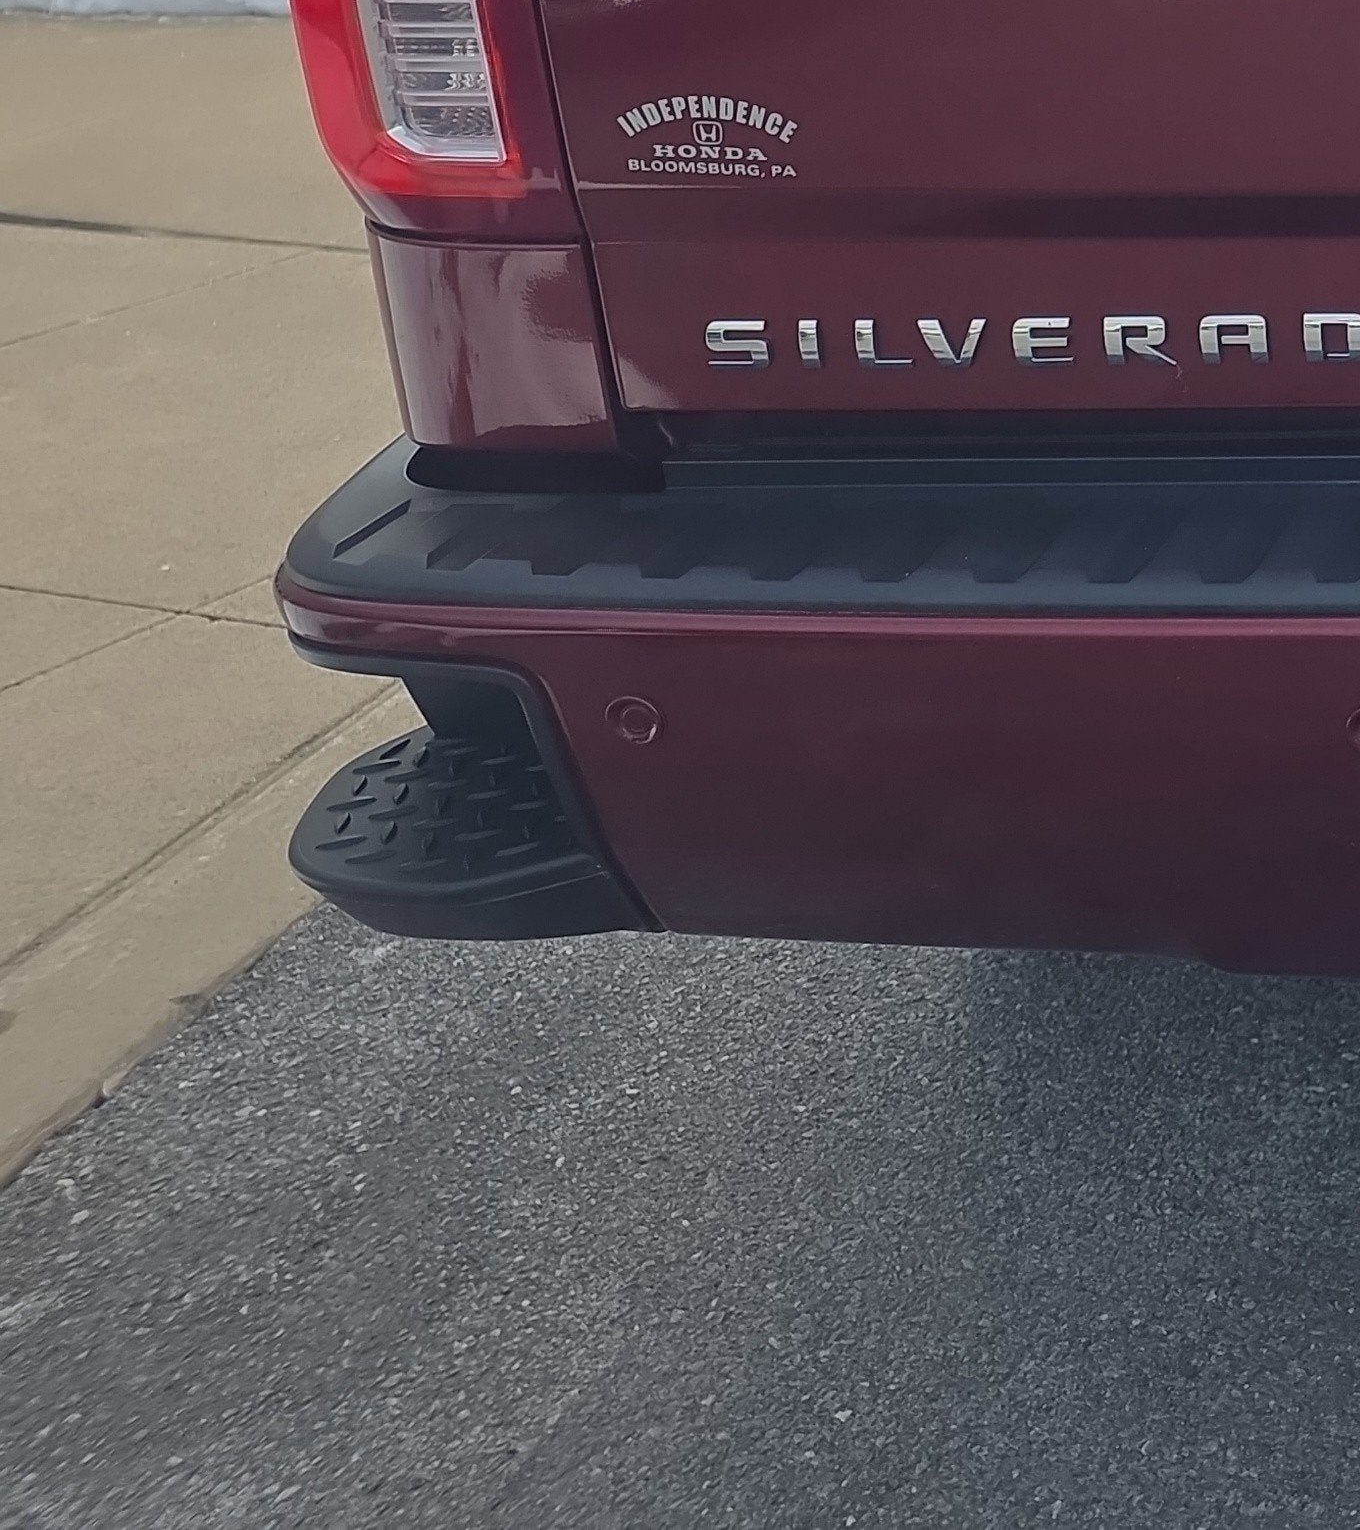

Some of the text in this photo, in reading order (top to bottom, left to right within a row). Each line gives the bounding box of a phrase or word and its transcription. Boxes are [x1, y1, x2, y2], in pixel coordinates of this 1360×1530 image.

[616, 94, 798, 144] INDEPENDENCE
[652, 143, 768, 161] HONDA
[627, 158, 797, 178] BLOOMSBURG, PA
